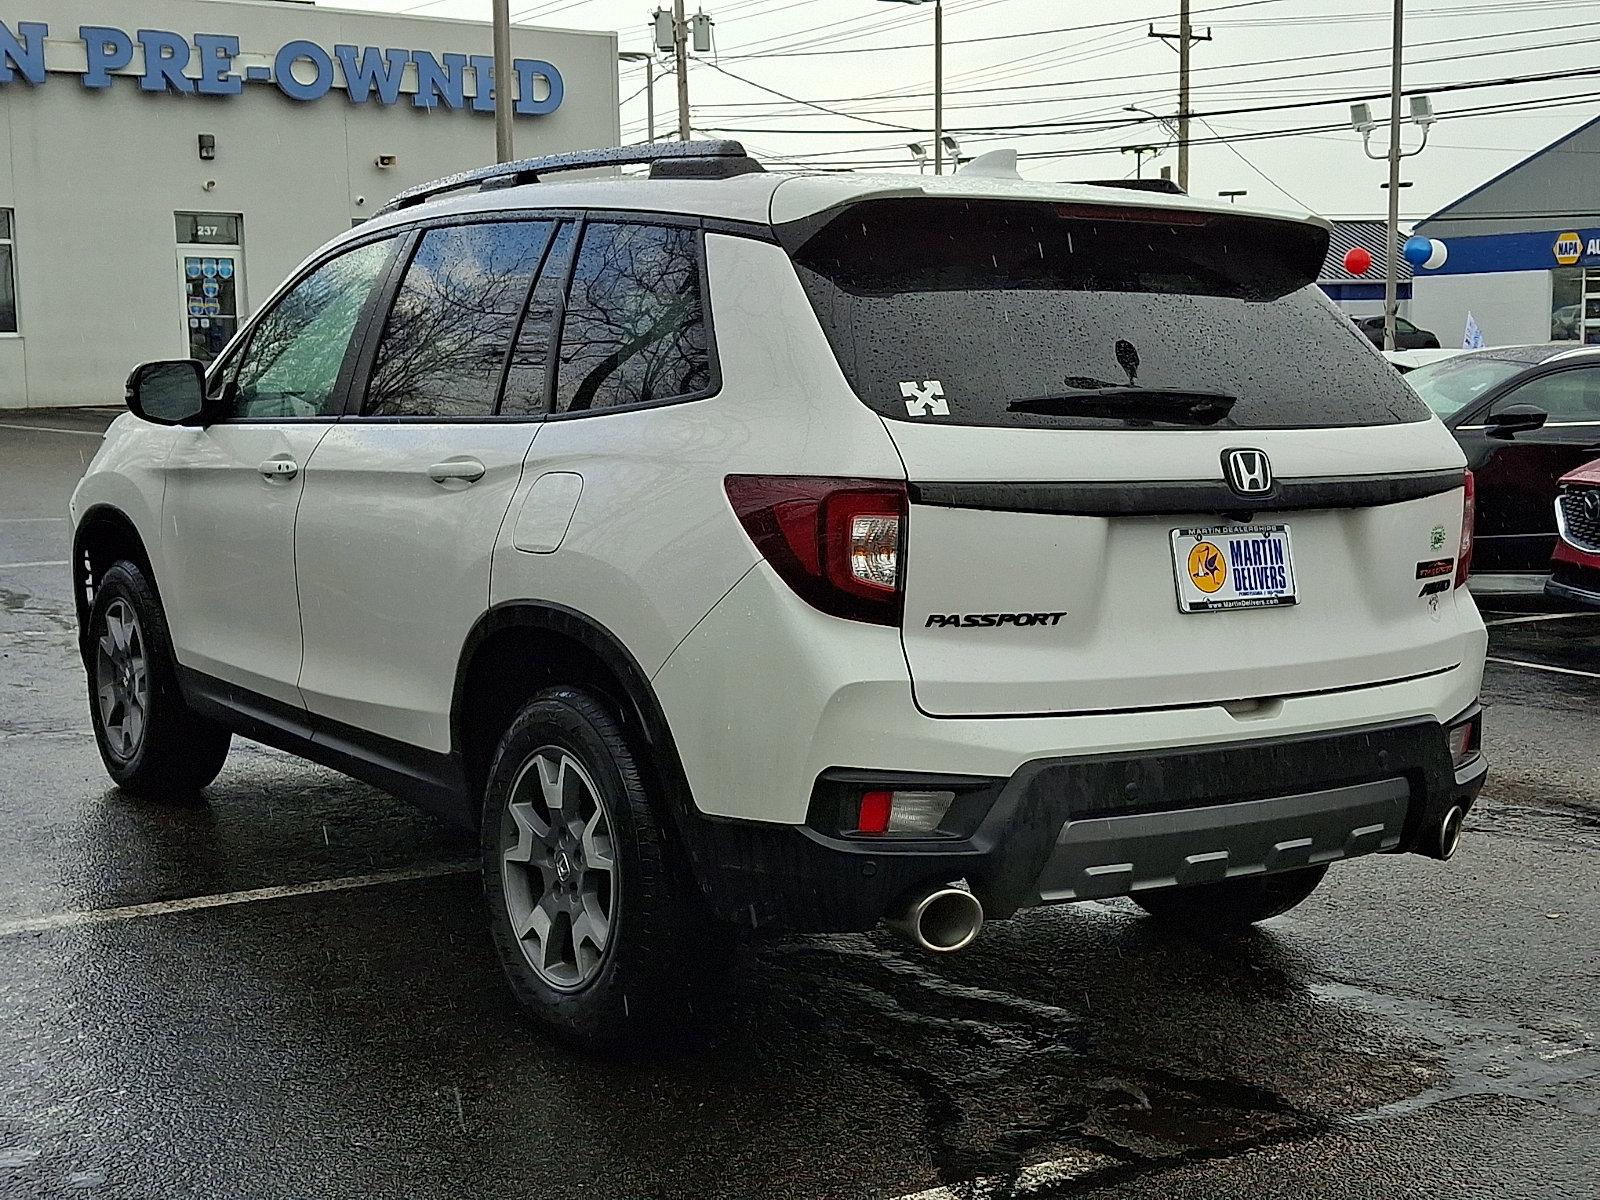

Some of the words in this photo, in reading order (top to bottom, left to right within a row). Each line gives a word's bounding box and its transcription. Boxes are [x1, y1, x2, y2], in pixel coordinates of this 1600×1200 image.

[79, 25, 565, 116] PRE-OWNED
[197, 226, 218, 236] 237
[1558, 241, 1578, 256] NAPA
[1188, 527, 1221, 536] MARTIN
[1223, 525, 1277, 534] DEALERSHIPS
[1229, 538, 1284, 567] MARTIN
[1232, 566, 1287, 592] DELIVERS
[1207, 598, 1279, 609] www.MartinDelivers.com
[925, 612, 1067, 628] PASSPORT
